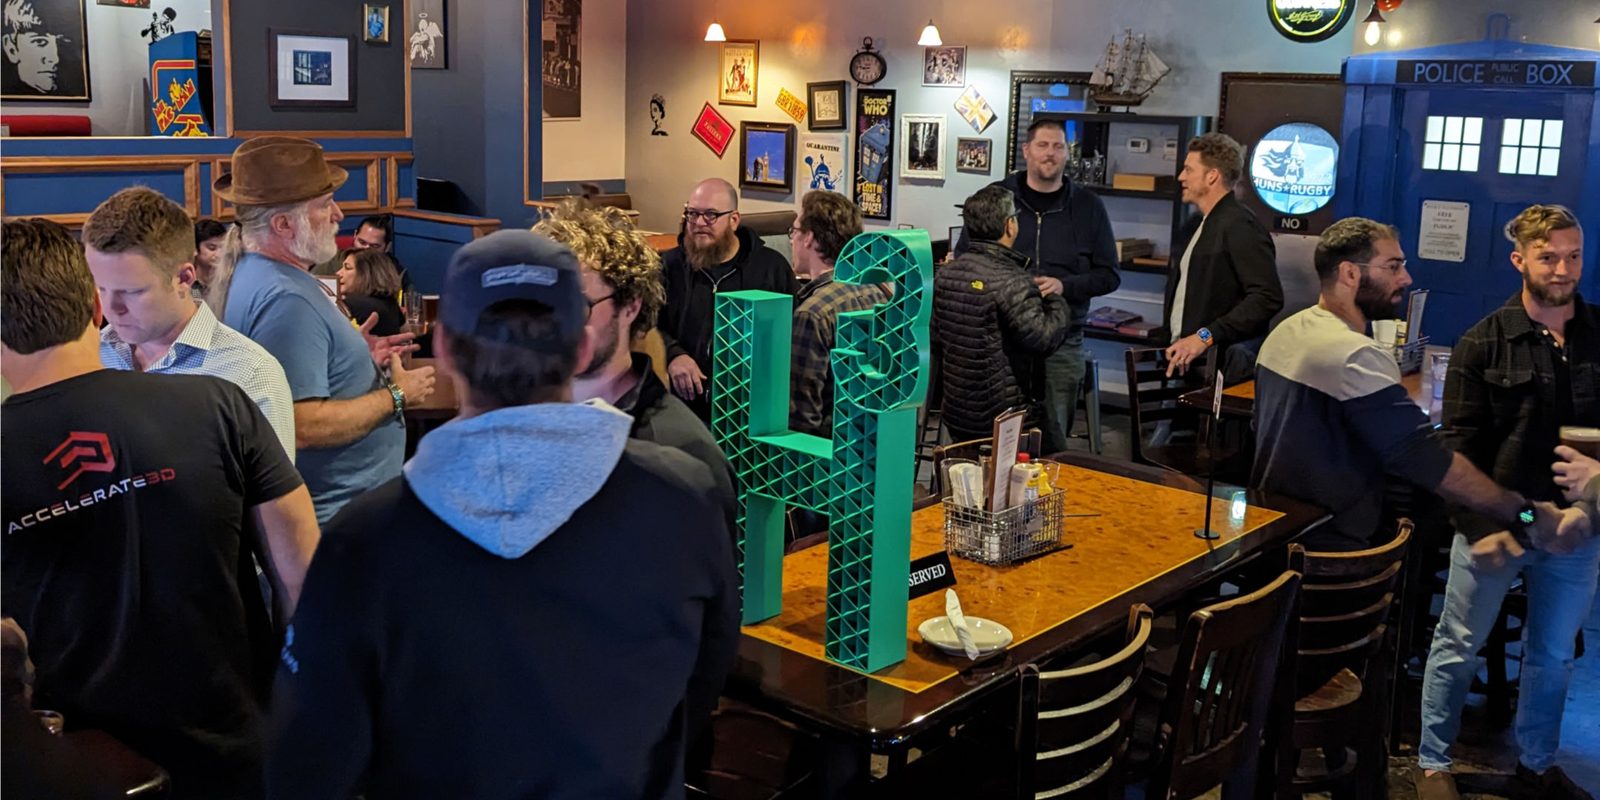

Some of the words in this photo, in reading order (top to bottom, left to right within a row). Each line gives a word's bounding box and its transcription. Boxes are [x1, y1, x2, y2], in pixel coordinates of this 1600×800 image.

[1414, 62, 1484, 83] POLICE
[1526, 63, 1574, 85] BOX
[1491, 63, 1519, 73] PUBLIC
[1493, 75, 1514, 84] CALL
[863, 96, 888, 105] DOCTOR
[864, 104, 888, 115] WHO
[806, 142, 840, 152] QUARANTINE
[862, 183, 876, 193] LOST
[1290, 185, 1332, 196] RUGBY
[1281, 218, 1300, 229] NO
[8, 468, 176, 535] ACCELERATE3D
[908, 563, 946, 587] SERVED
